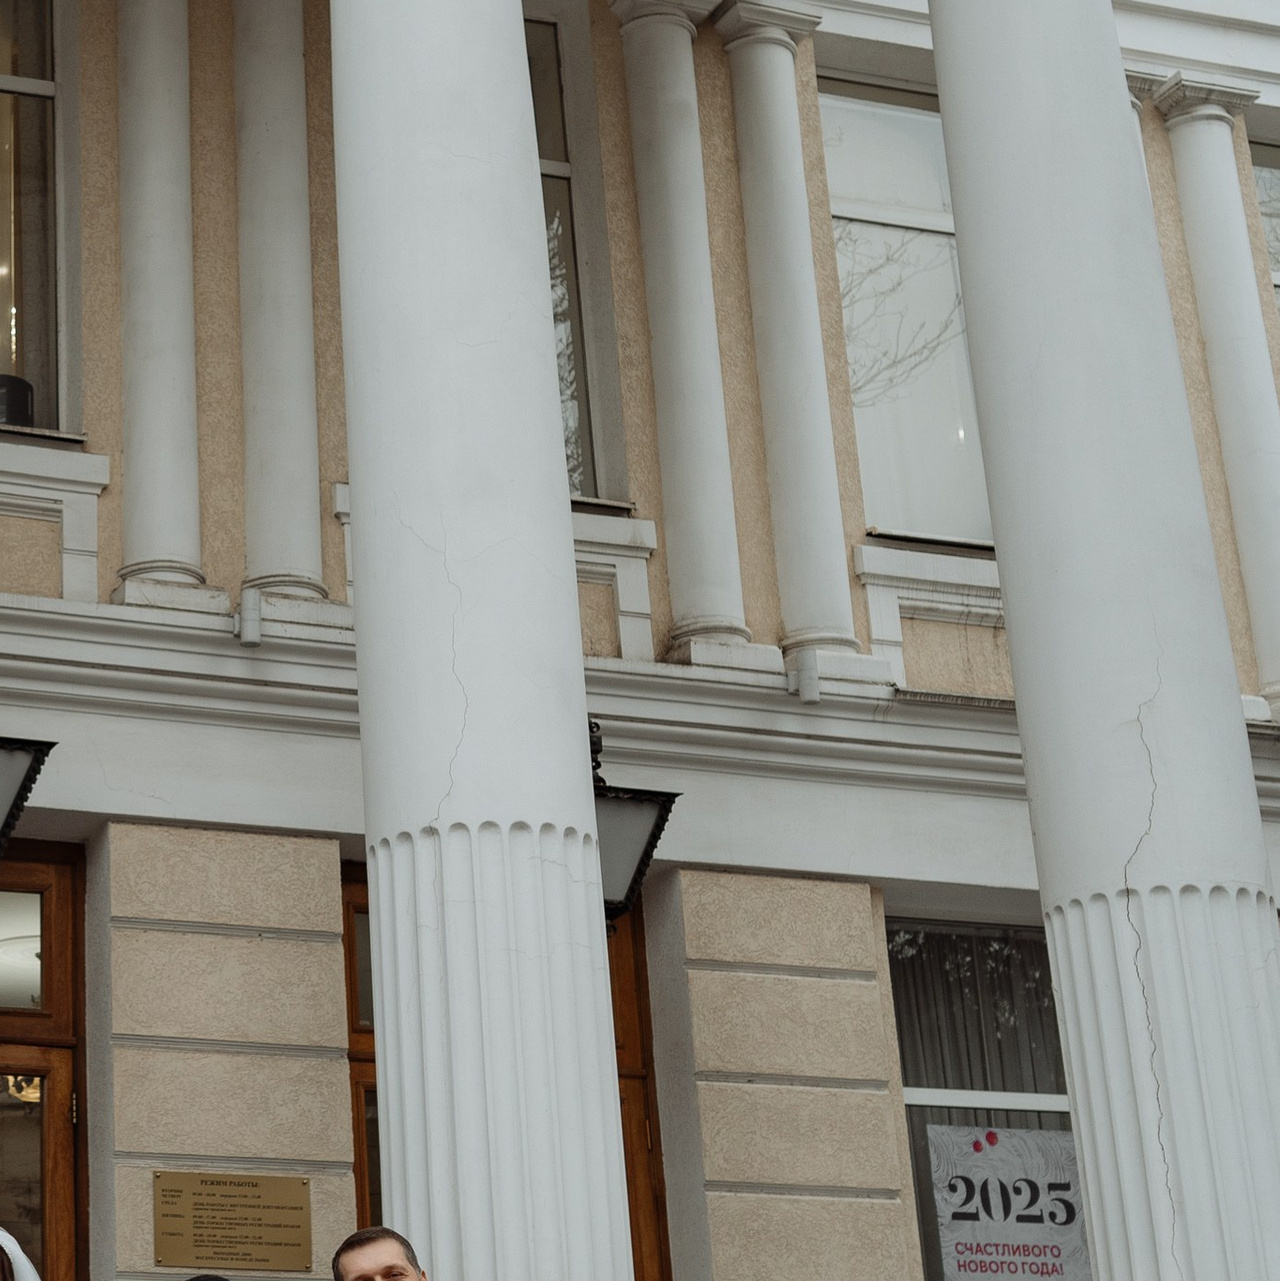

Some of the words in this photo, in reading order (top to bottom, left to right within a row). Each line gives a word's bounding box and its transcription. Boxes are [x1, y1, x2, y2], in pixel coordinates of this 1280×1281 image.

[948, 1175, 1077, 1226] 2025
[954, 1241, 1062, 1258] СЧАСТЛИВОГО
[957, 1258, 1019, 1275] НОВОГО
[1021, 1261, 1064, 1277] ГОДА!
